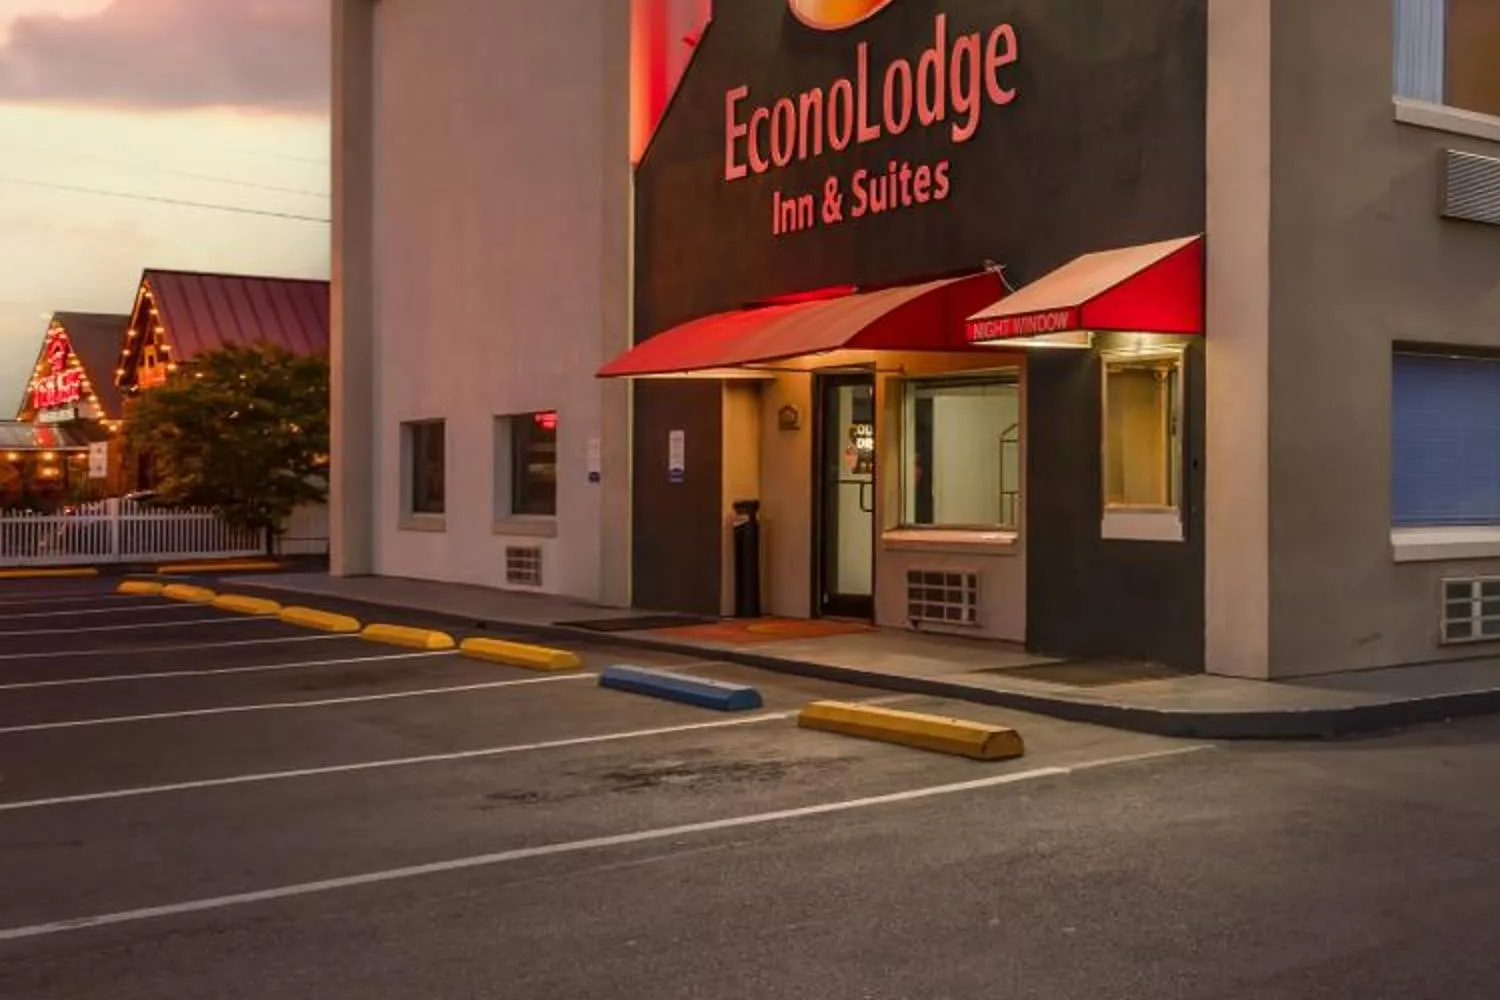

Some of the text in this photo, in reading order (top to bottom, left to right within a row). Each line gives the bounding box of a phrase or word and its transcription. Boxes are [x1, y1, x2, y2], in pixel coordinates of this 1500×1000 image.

[725, 13, 1018, 182] EconoLodge
[772, 160, 950, 235] Inn & Suites
[973, 310, 1069, 341] NIGHT WINDOW
